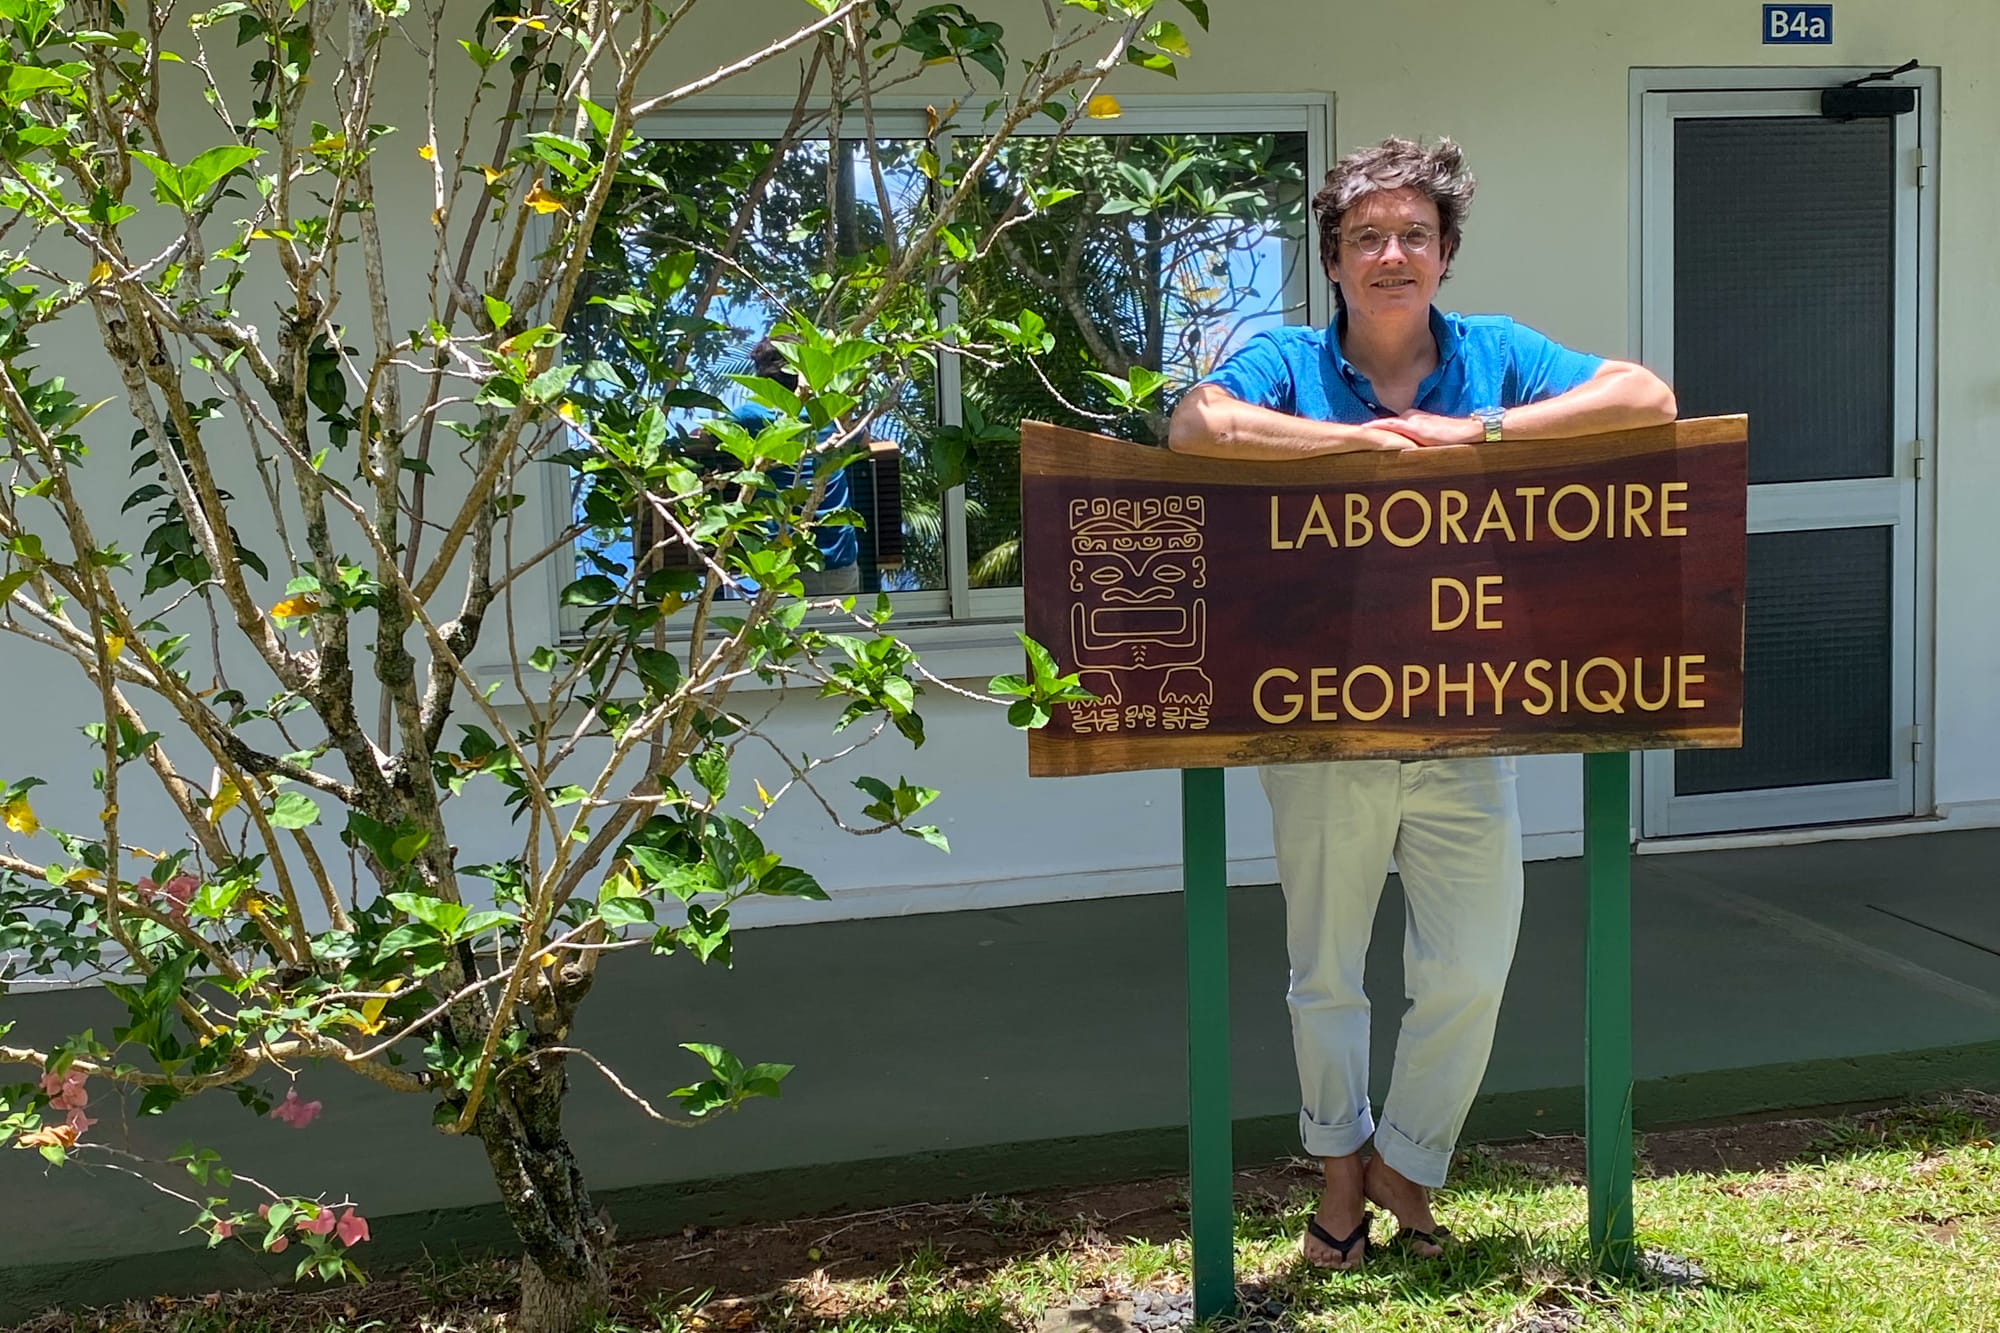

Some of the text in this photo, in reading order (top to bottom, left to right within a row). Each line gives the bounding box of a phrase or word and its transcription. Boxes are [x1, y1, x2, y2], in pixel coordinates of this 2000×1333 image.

[1771, 10, 1825, 38] B4a
[1272, 482, 1687, 549] LABORATOIRE
[1432, 576, 1502, 631] DE
[1253, 655, 1705, 723] GEOPHYSIQUE
